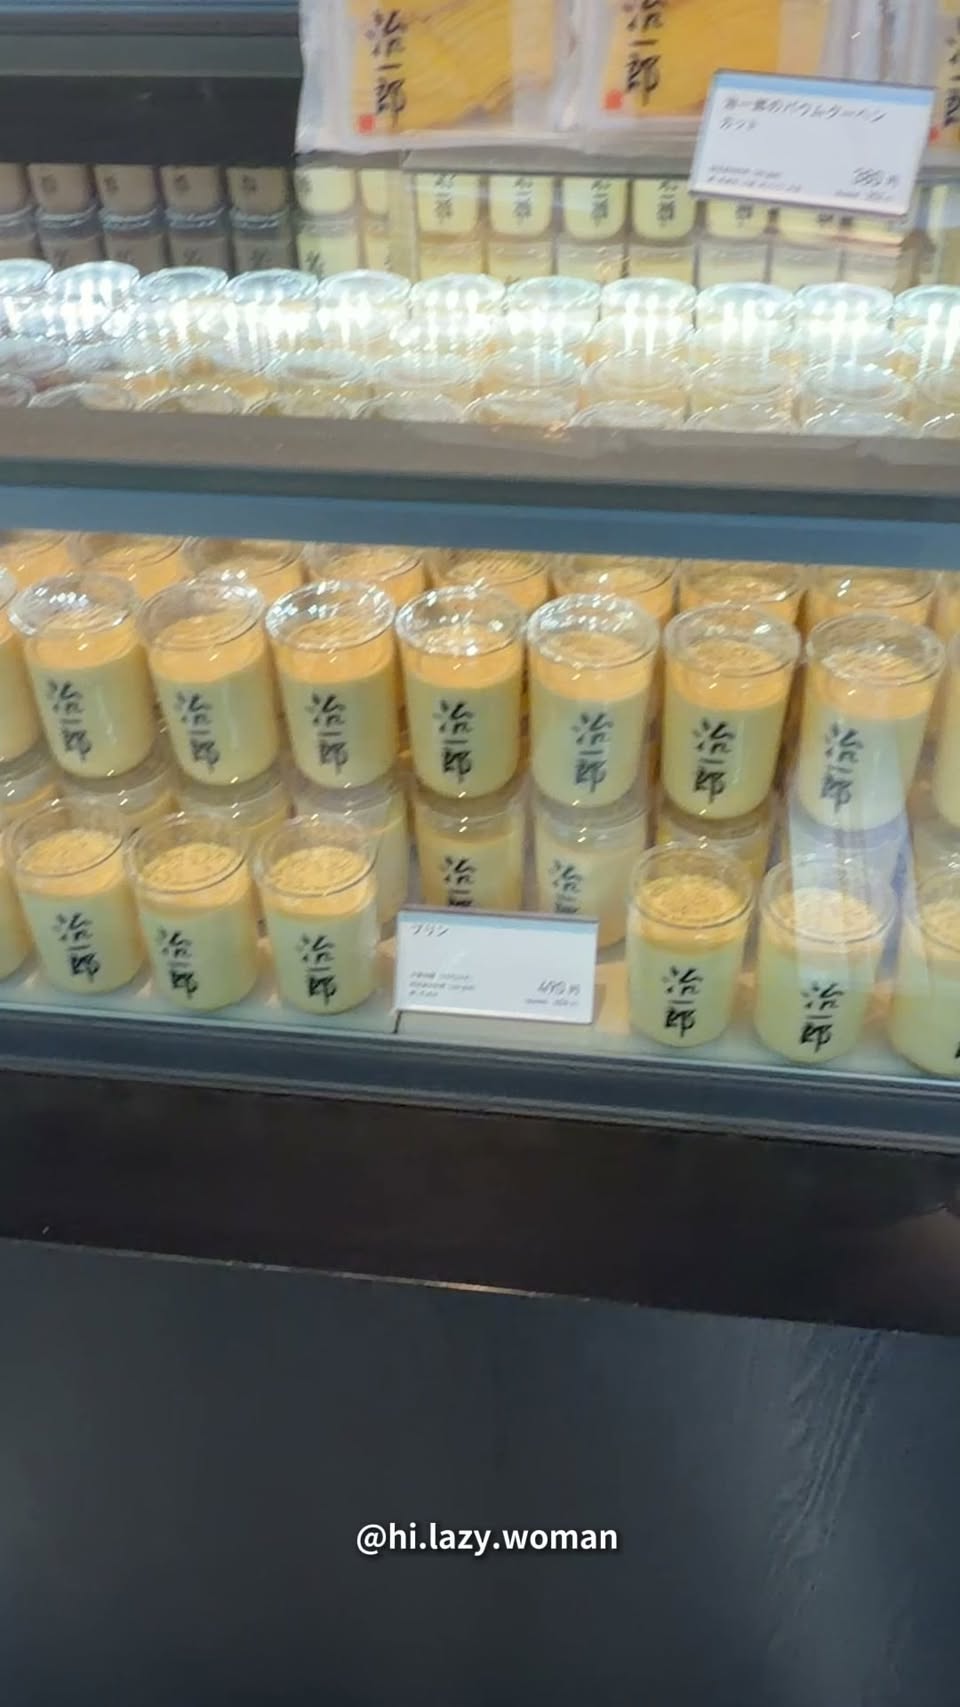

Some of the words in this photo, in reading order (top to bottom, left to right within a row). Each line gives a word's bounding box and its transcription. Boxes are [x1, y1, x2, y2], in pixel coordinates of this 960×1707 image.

[365, 8, 408, 129] 治一郎
[46, 679, 92, 763] 治一郎
[174, 690, 221, 774] 治一郎
[306, 692, 349, 776] 治一郎
[432, 699, 476, 784] 治一郎
[570, 711, 614, 793] 治一郎
[691, 716, 736, 803] 治一郎
[818, 720, 863, 813] 治一郎
[53, 912, 102, 983] 治一郎
[156, 926, 200, 999] 治一郎
[299, 932, 338, 1006] 治一郎
[661, 965, 704, 1038] 治一郎
[800, 981, 845, 1053] 治一郎
